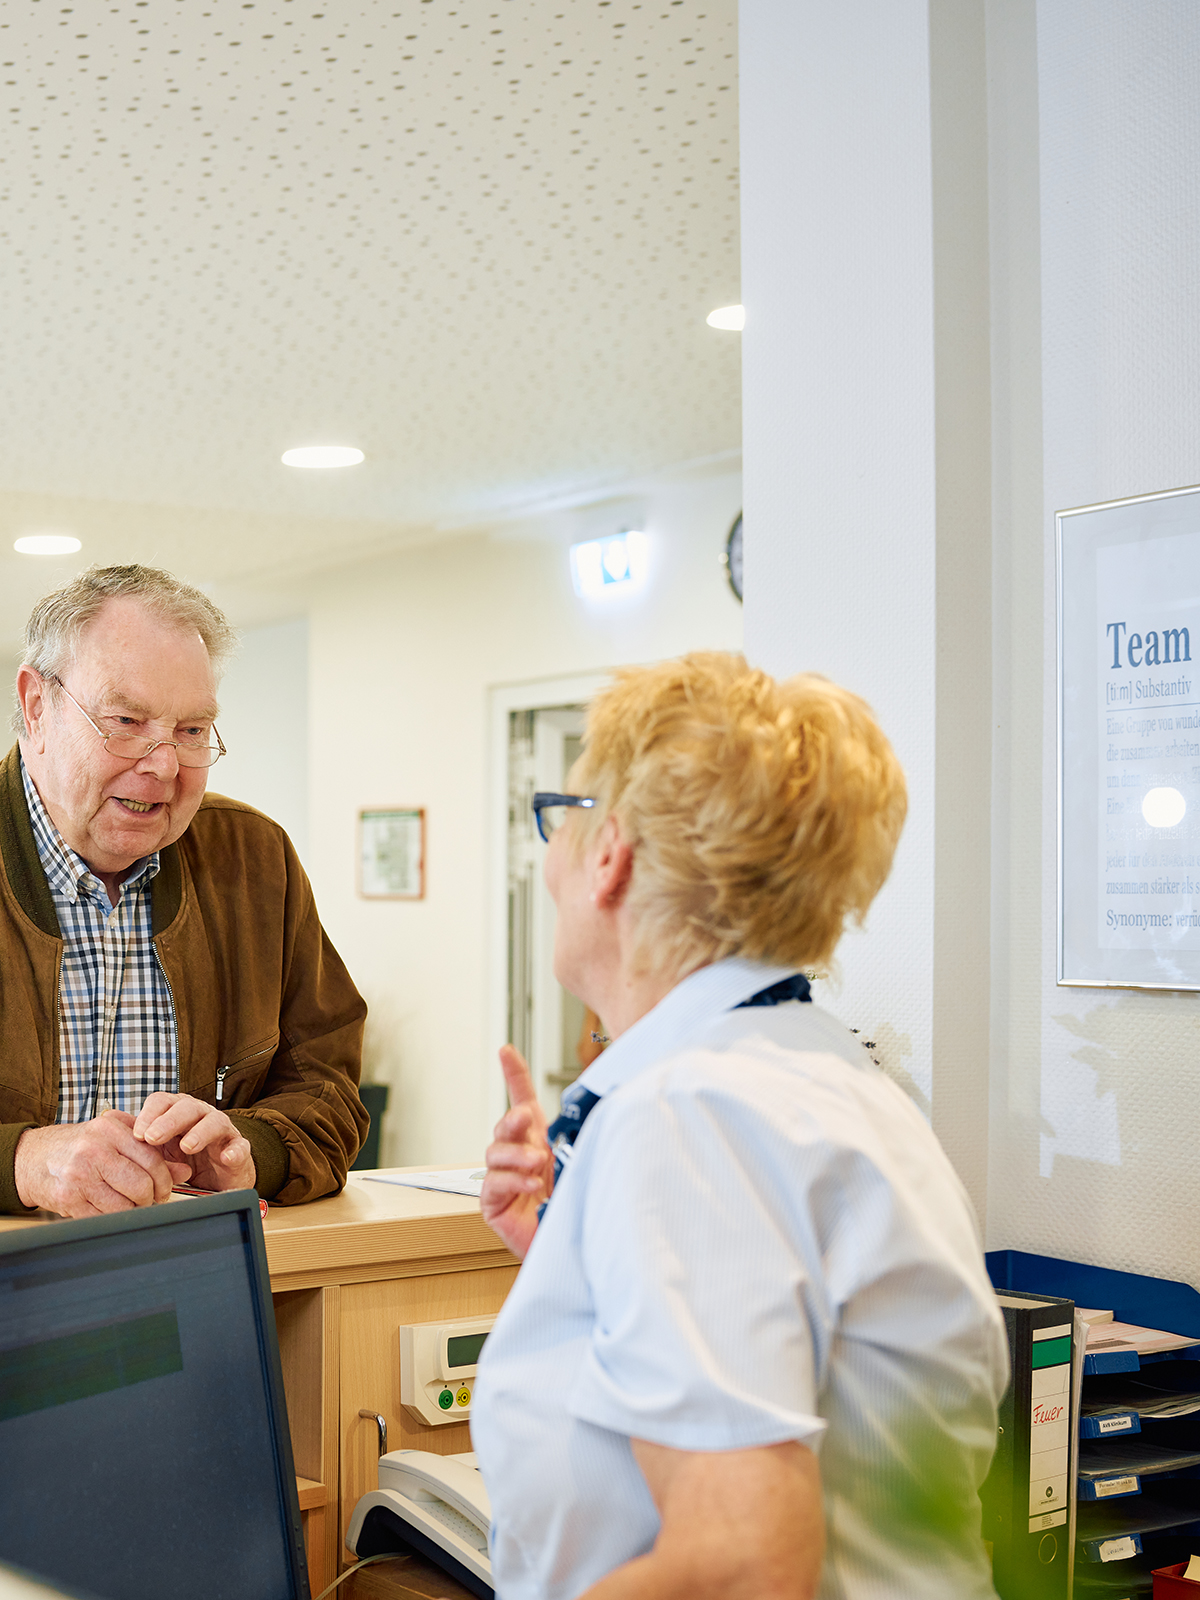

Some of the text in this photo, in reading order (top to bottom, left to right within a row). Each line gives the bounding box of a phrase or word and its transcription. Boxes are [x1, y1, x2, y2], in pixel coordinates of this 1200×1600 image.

[1106, 621, 1192, 669] Team
[1135, 675, 1192, 699] Substantiv
[1106, 717, 1124, 736] Eine
[1126, 716, 1156, 738] Gruppe
[1158, 717, 1173, 731] von
[1106, 743, 1119, 762] die
[1106, 881, 1149, 895] zusammen
[1150, 876, 1181, 895] stärker
[1181, 875, 1194, 894] als
[1106, 908, 1173, 932] Synonyme:
[1033, 1403, 1064, 1424] Feuer
